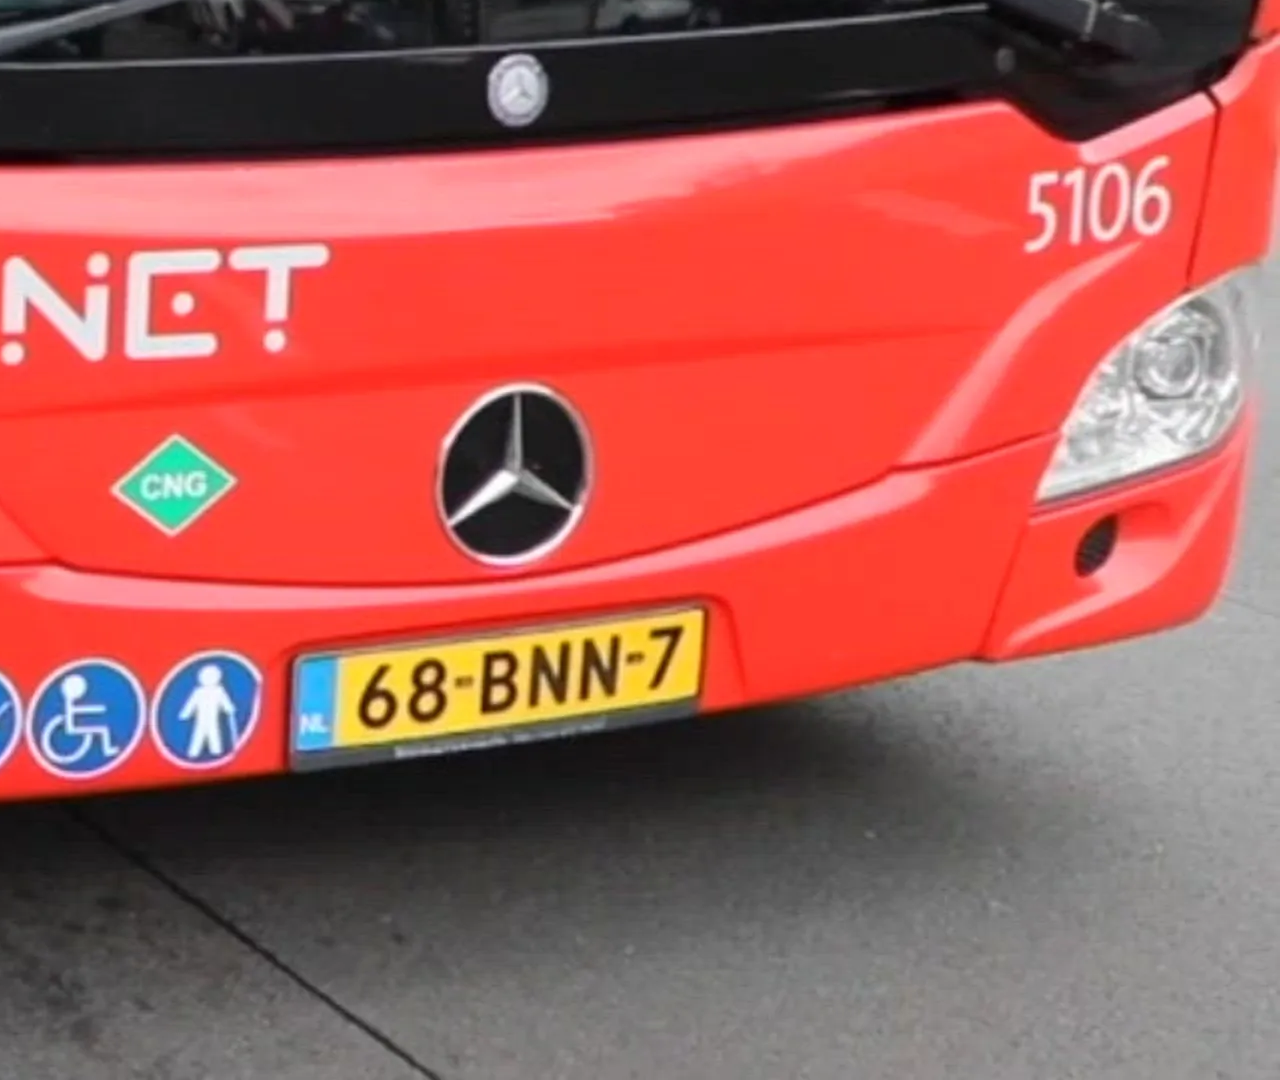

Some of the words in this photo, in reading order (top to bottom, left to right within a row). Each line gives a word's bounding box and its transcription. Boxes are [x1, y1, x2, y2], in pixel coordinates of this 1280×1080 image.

[1023, 154, 1171, 254] 5106
[140, 470, 208, 502] CNG
[357, 625, 685, 730] 68-BNN-7
[299, 712, 328, 736] NL
